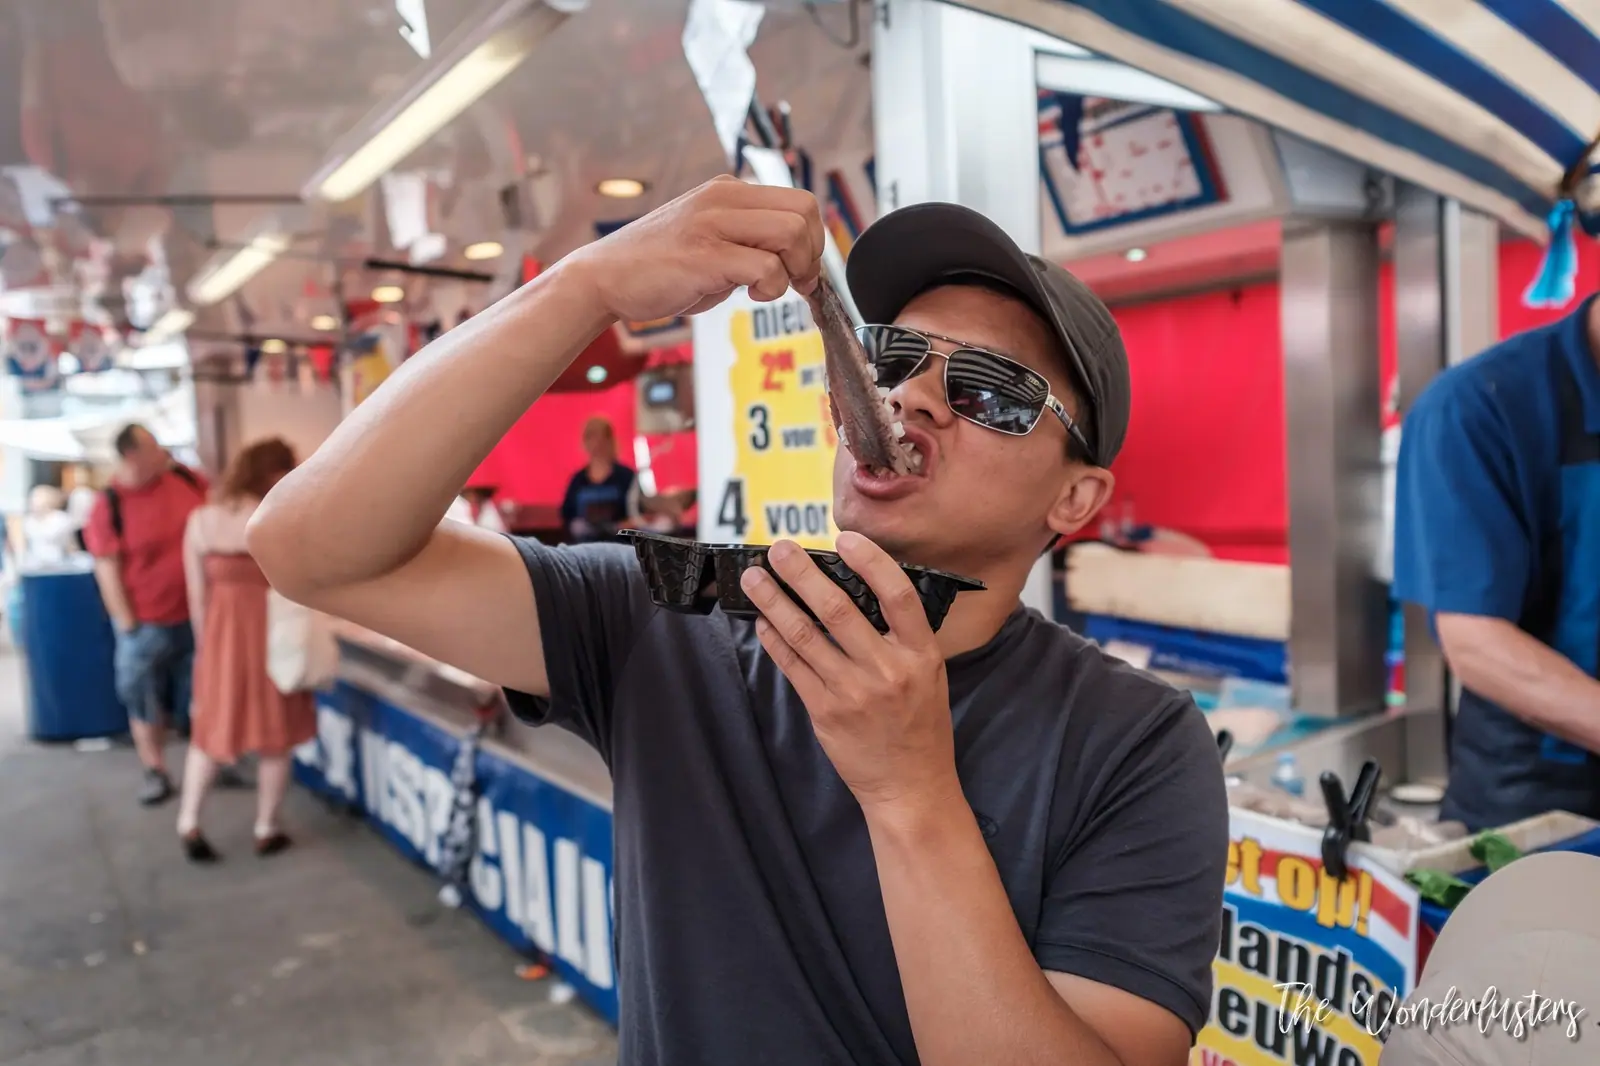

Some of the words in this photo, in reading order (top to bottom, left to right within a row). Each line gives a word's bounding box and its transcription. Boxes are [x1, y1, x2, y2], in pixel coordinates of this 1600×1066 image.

[749, 405, 770, 450] 3
[718, 478, 748, 537] 4
[1276, 856, 1374, 937] op!
